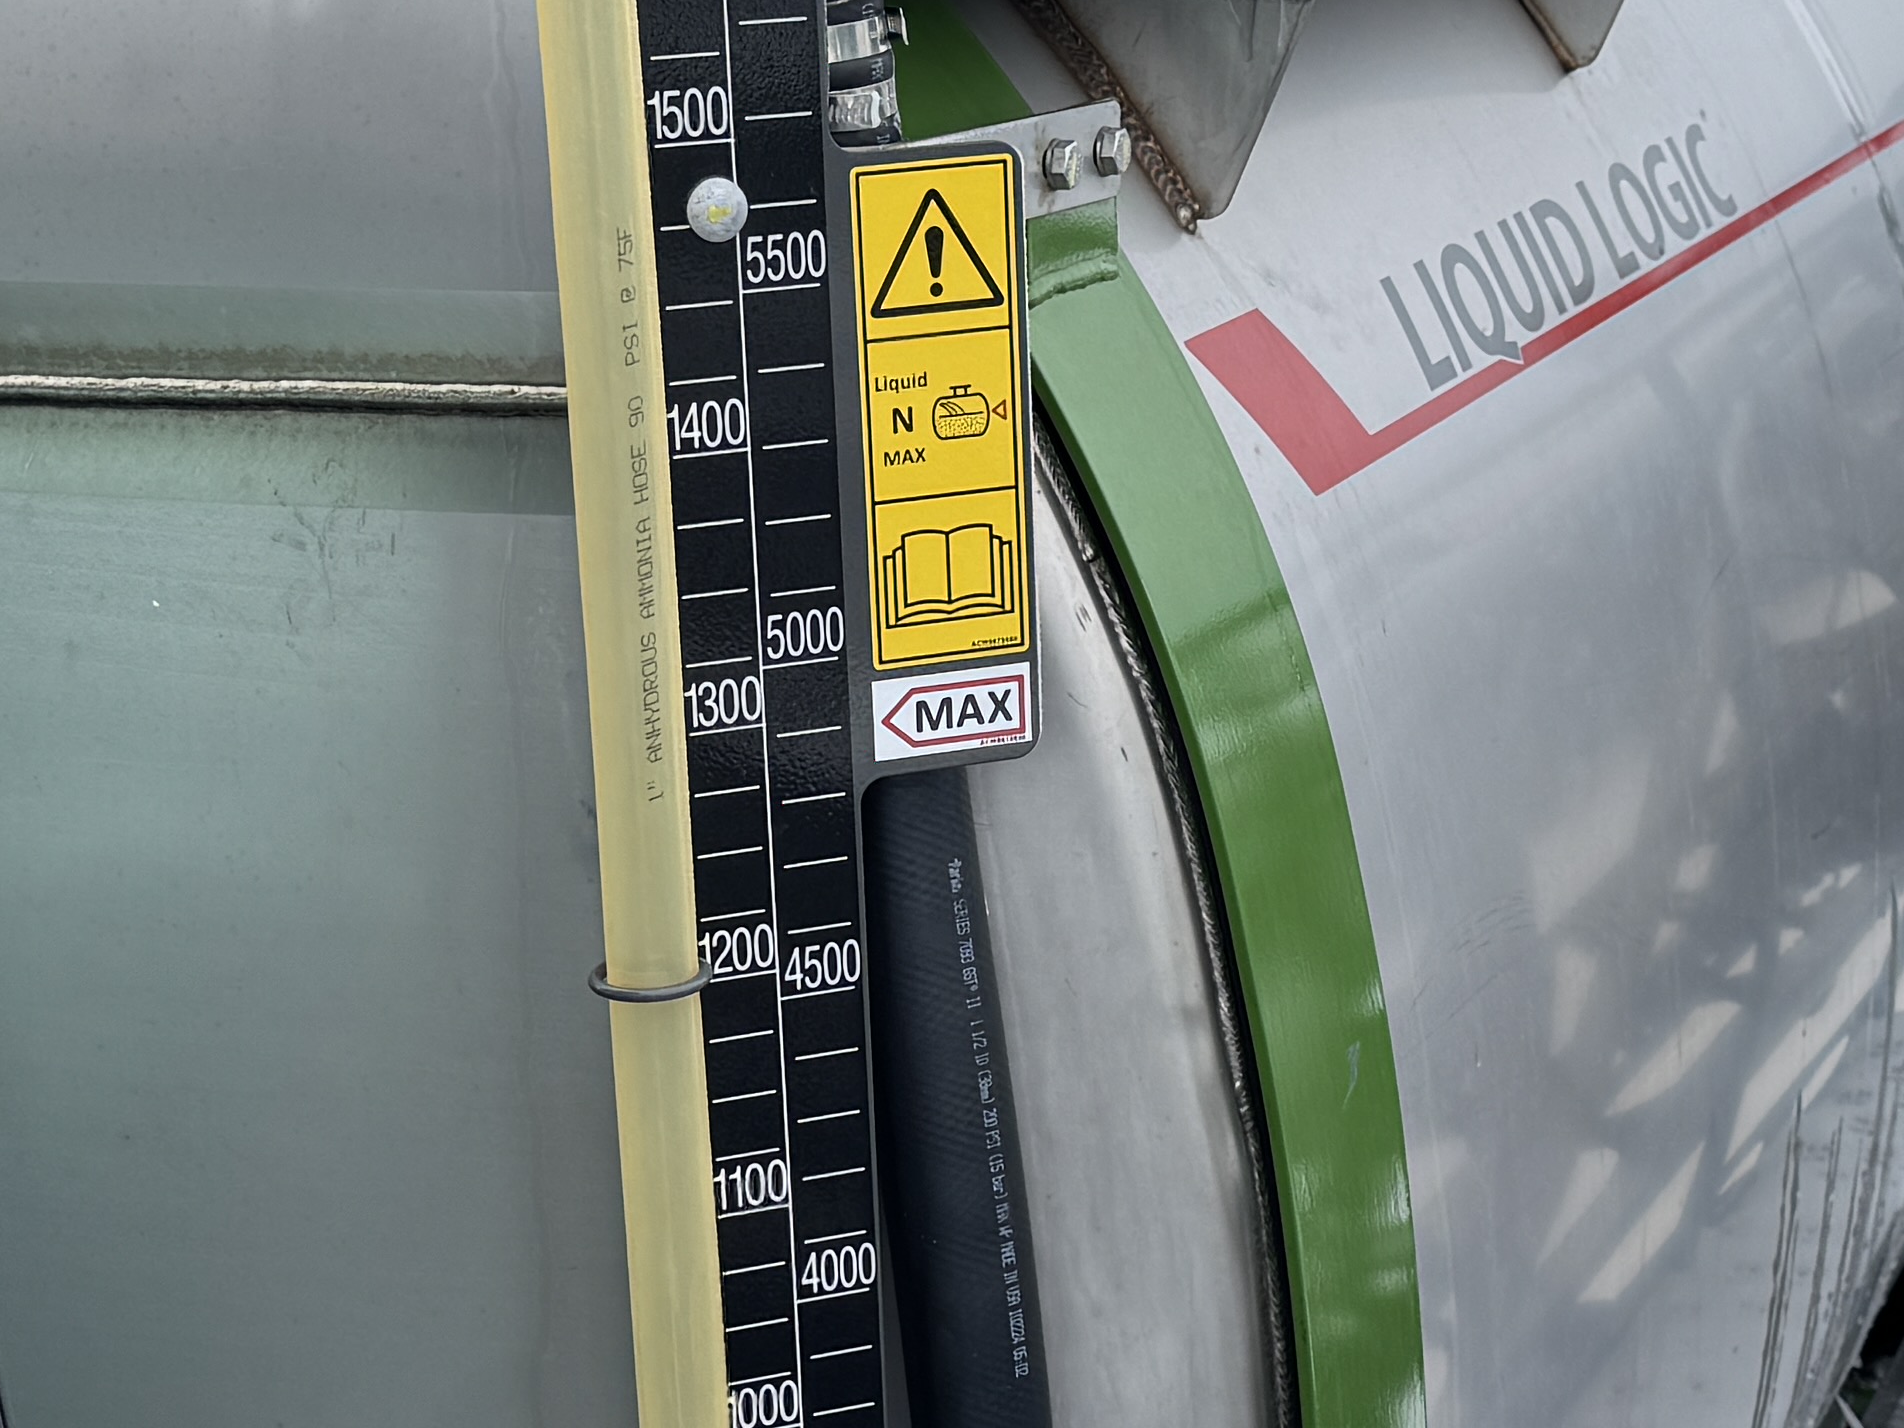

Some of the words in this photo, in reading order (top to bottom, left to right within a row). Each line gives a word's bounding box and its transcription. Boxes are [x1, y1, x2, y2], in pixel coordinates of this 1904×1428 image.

[647, 86, 729, 141] 1500
[617, 227, 634, 272] 75F
[746, 229, 826, 284] 5500
[1380, 198, 1596, 394] LIQUID
[1577, 122, 1738, 280] LOGIC
[623, 322, 640, 366] PSI
[874, 372, 929, 393] Liquid
[628, 395, 644, 428] 90
[667, 395, 746, 451] 1400
[892, 406, 914, 434] N
[631, 439, 649, 505] HOSE
[883, 447, 927, 468] MAX
[636, 516, 655, 619] AMMONIA
[766, 603, 844, 657] 5000
[641, 632, 663, 764] ANHYDROUS
[684, 673, 763, 728] 1300
[915, 688, 1013, 734] MAX
[954, 899, 970, 935] SERIES
[700, 923, 774, 977] 1200
[785, 939, 861, 992] 4500
[713, 1158, 787, 1212] 1100
[801, 1241, 877, 1294] 4000
